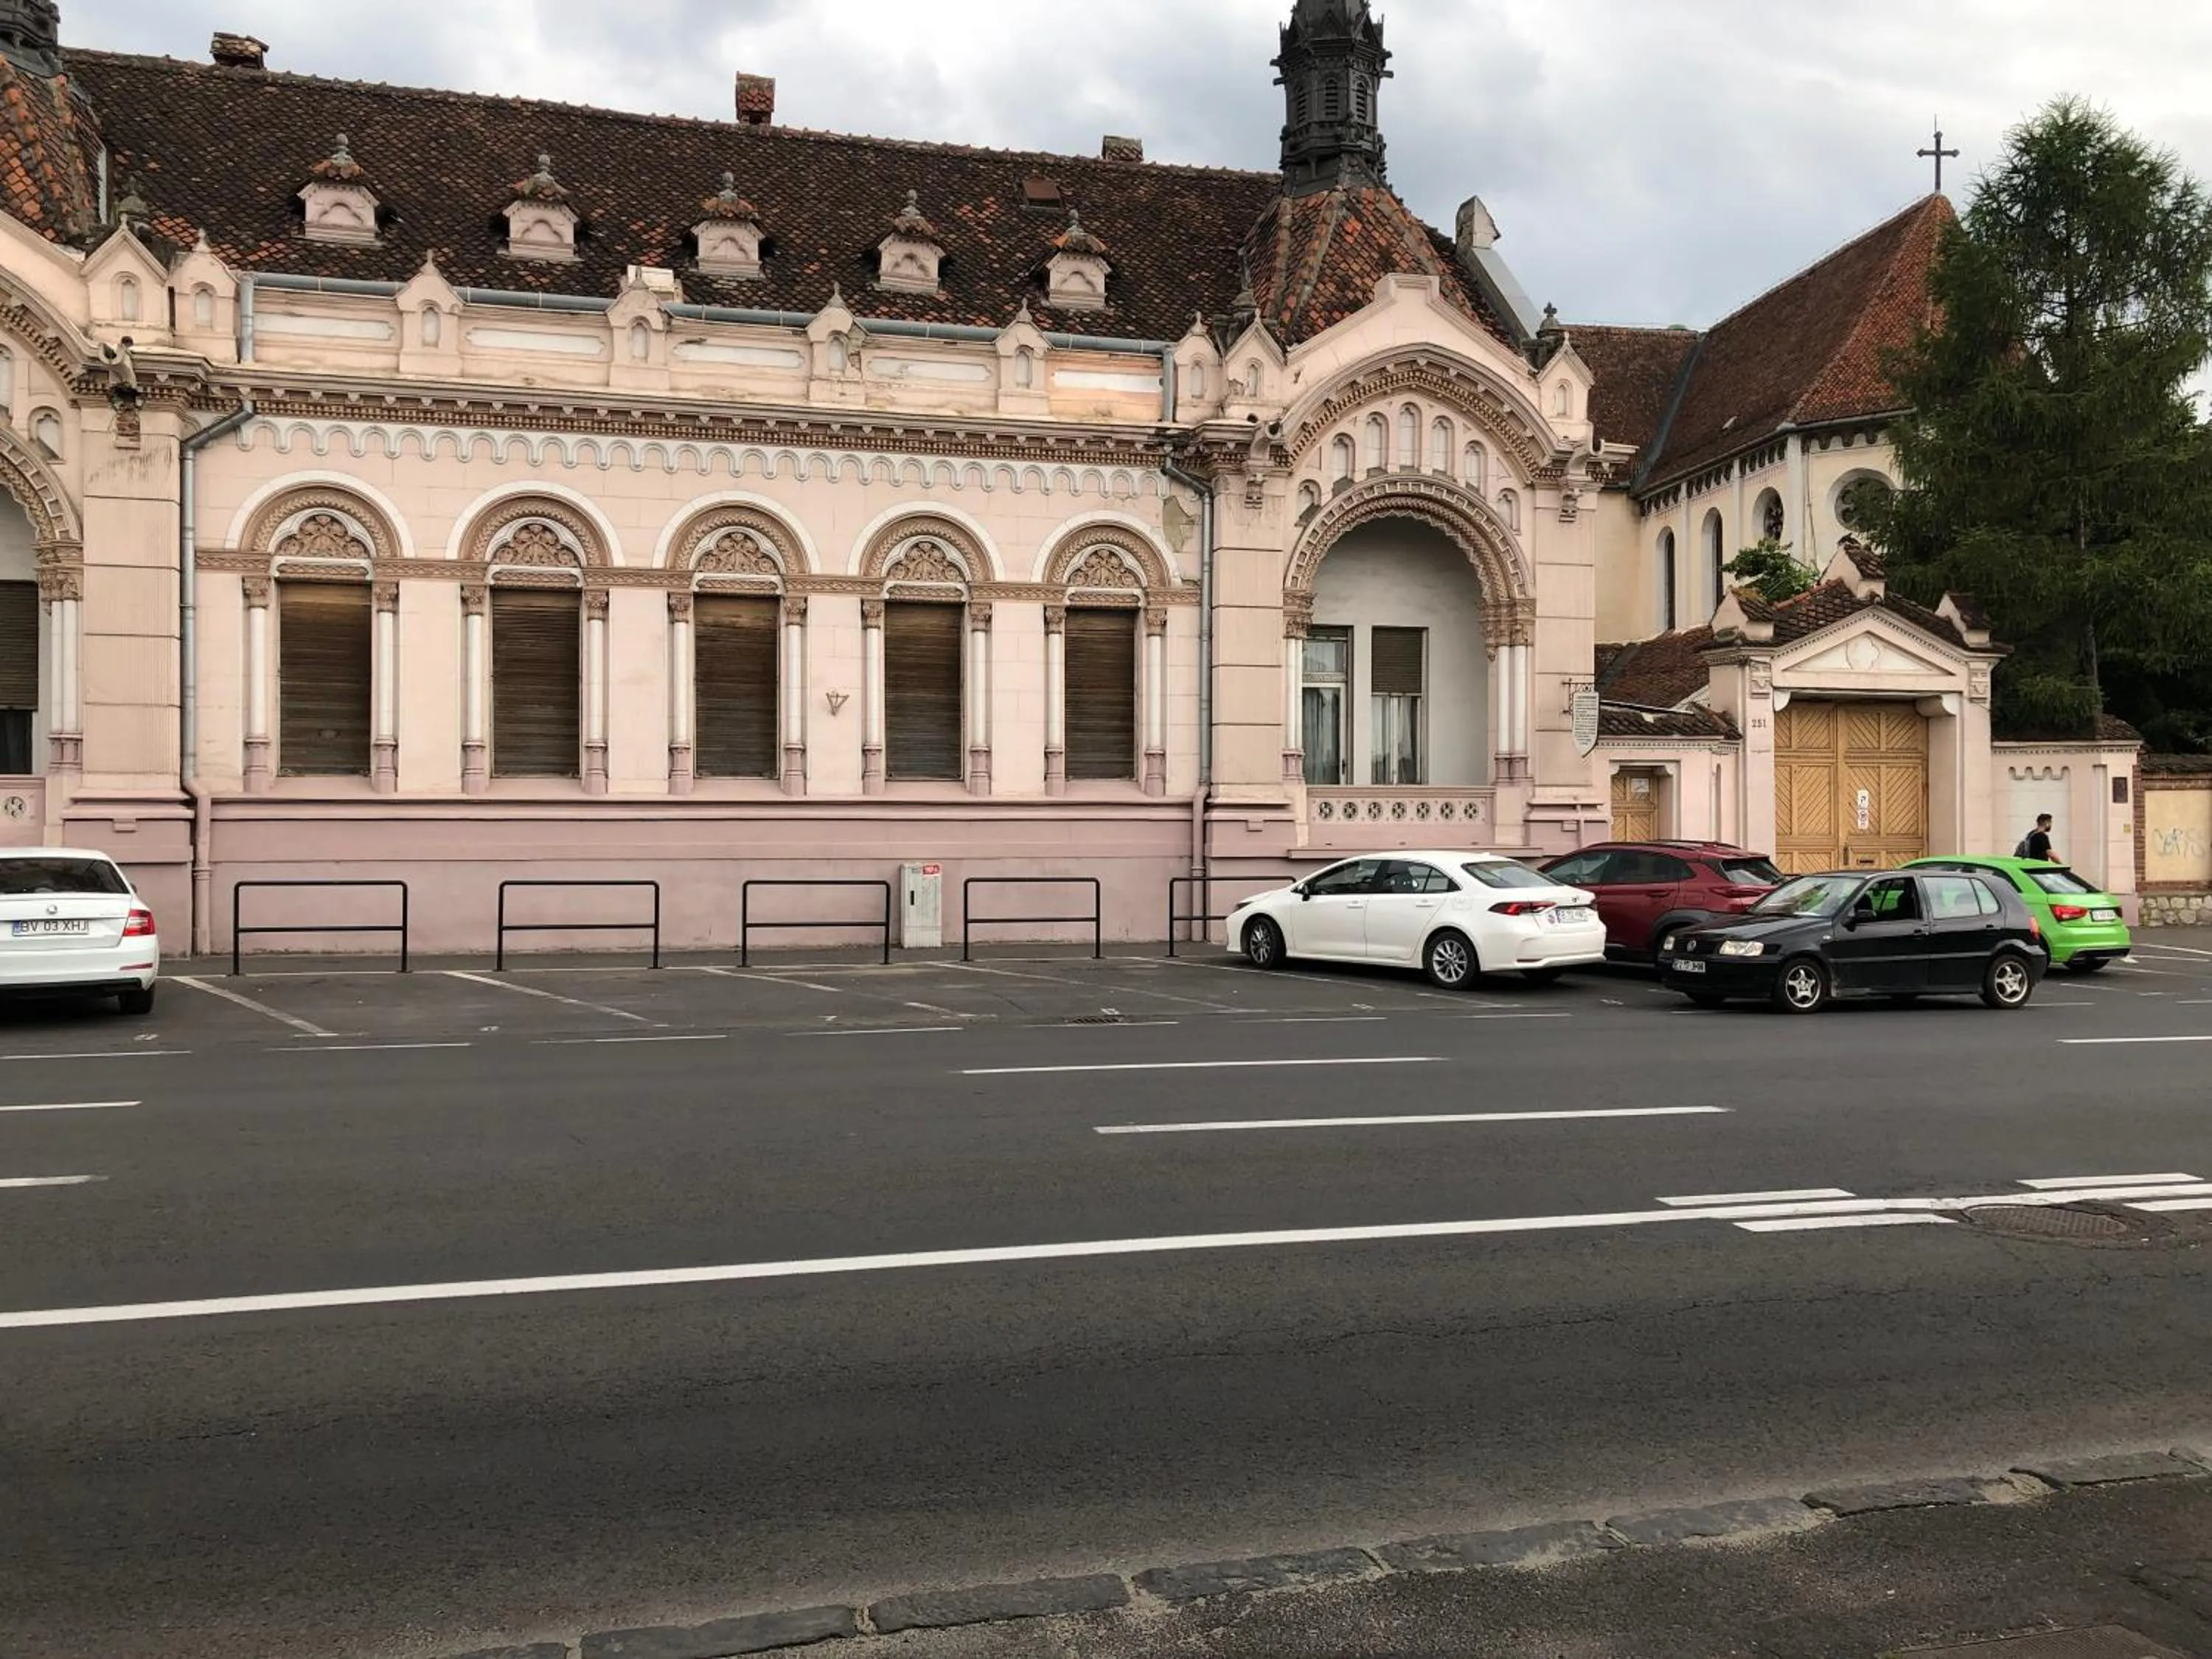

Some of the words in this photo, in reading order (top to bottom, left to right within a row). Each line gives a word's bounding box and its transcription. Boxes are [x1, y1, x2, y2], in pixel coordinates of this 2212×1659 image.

[1751, 719, 1767, 728] 251
[21, 919, 38, 932] BV
[44, 921, 58, 931] 03
[63, 919, 86, 931] XHJ
